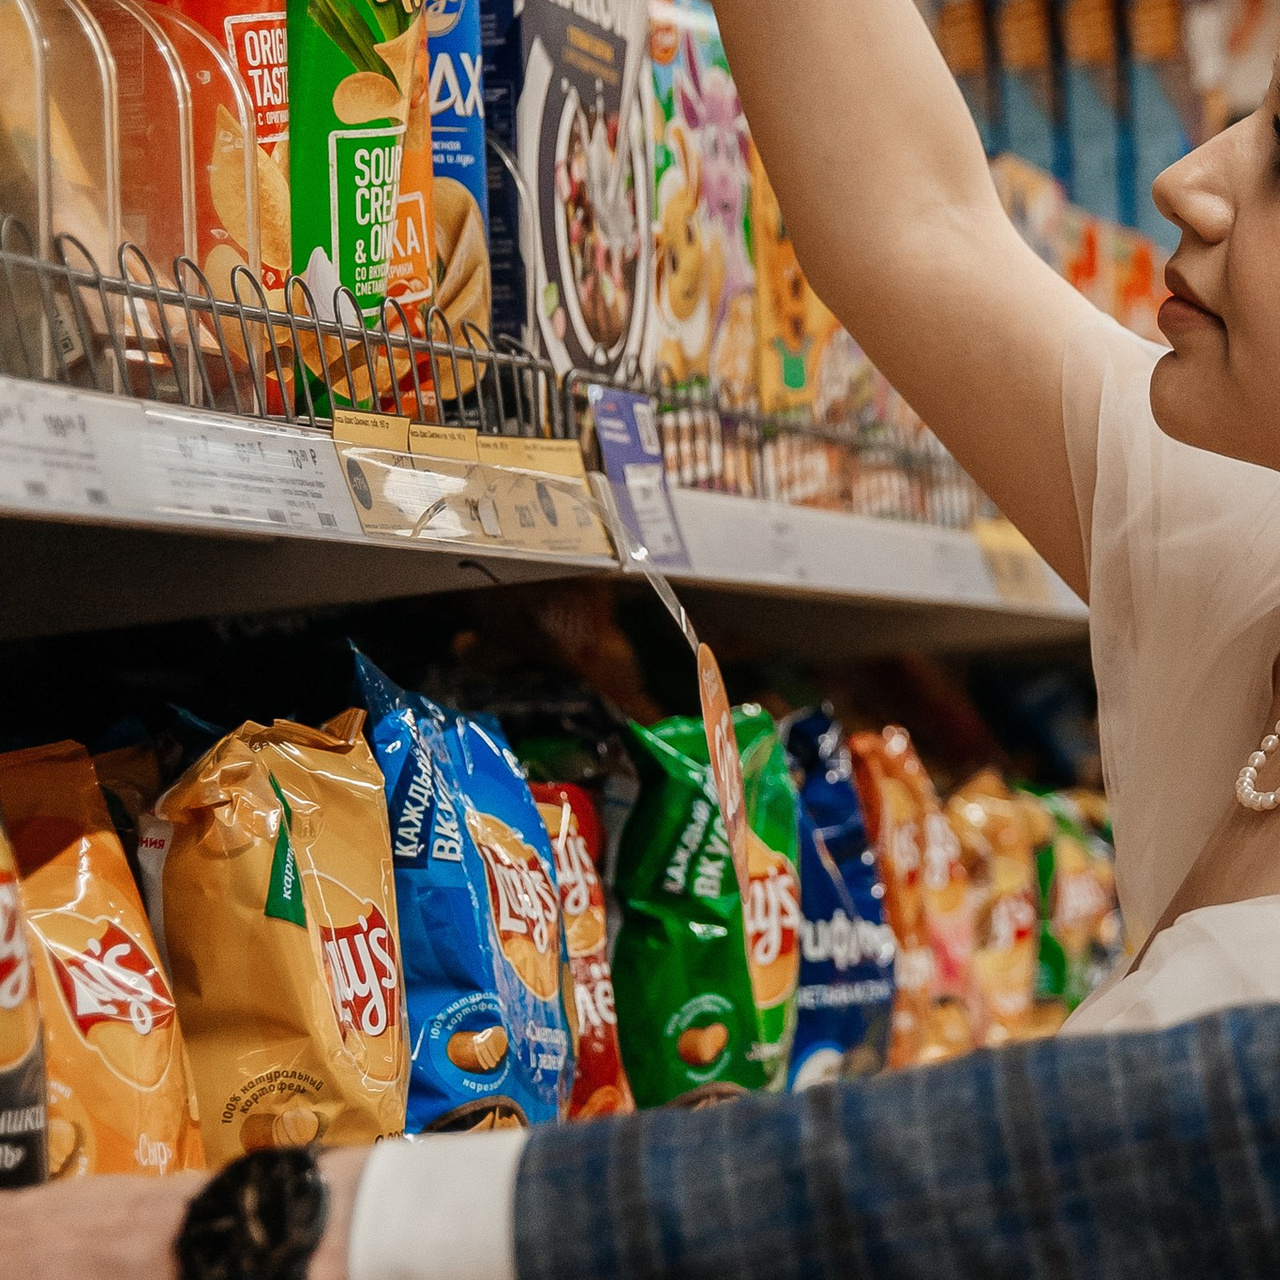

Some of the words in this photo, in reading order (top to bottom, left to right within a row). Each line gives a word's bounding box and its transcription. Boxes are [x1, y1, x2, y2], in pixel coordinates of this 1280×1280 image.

[221, 1092, 241, 1125] 100%
[240, 1069, 325, 1096] натуральный
[239, 1080, 309, 1115] картофель
